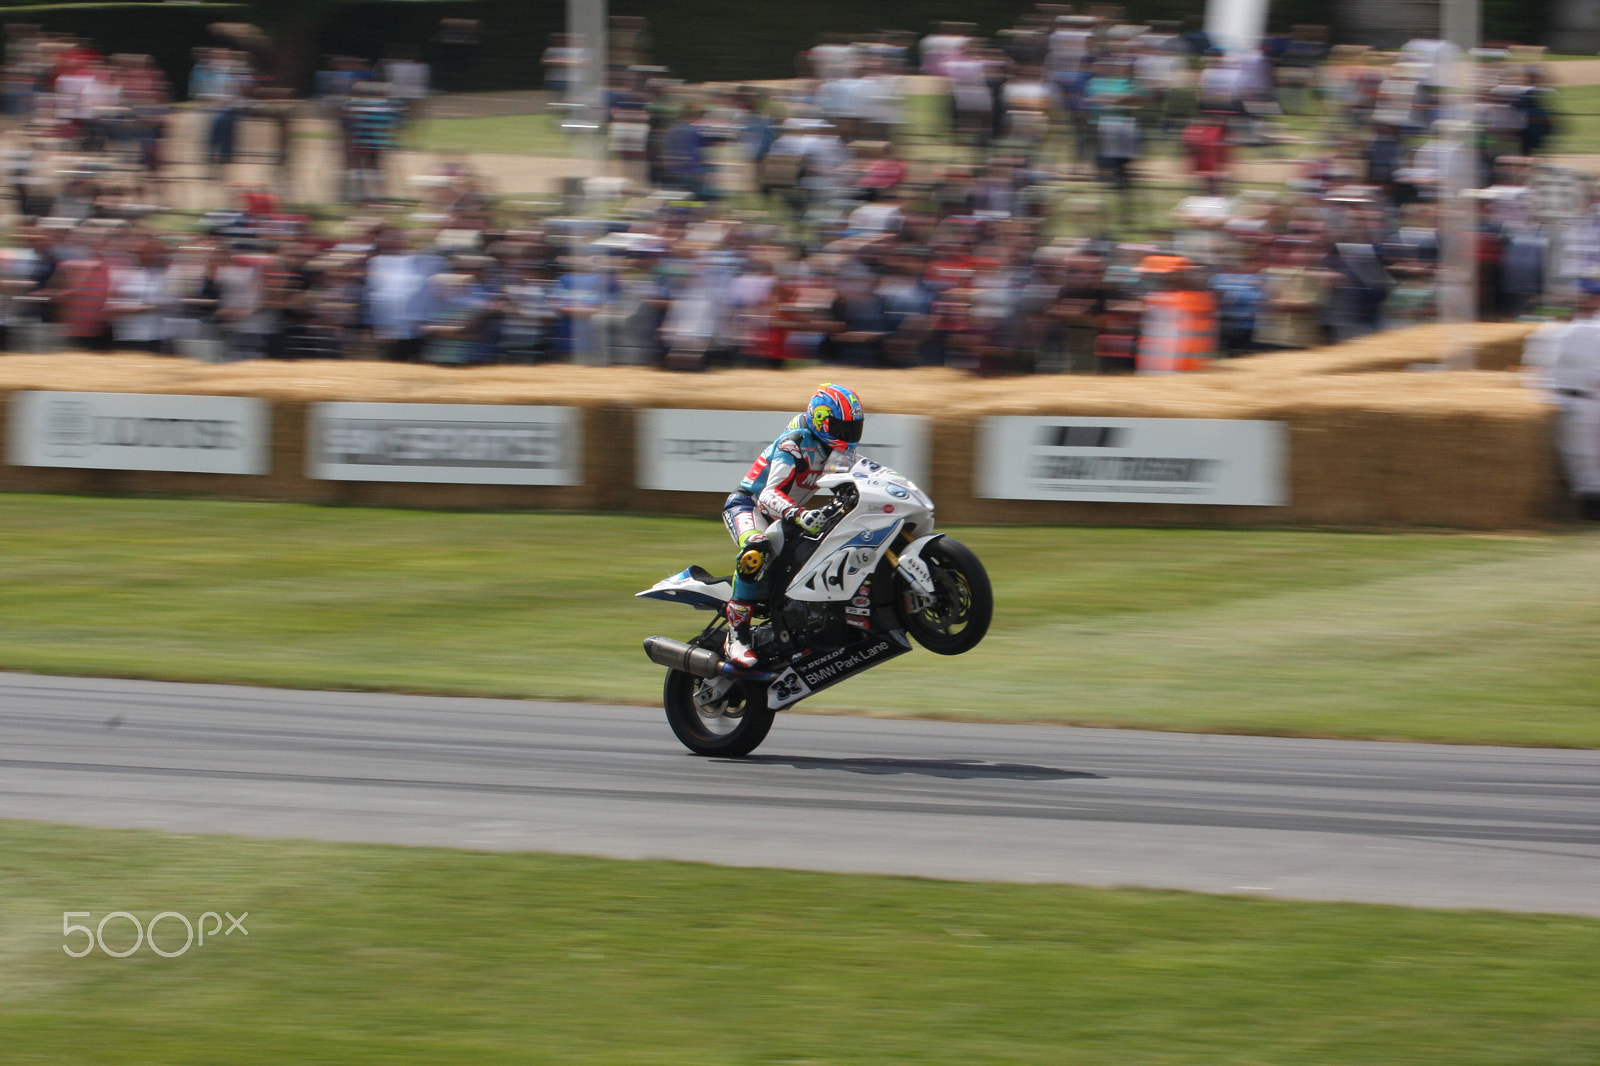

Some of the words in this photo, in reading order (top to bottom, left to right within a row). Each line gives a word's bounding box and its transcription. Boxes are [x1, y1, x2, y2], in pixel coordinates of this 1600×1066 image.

[805, 665, 838, 685] BMW
[834, 655, 862, 672] Park
[858, 641, 890, 660] Lane
[807, 647, 846, 669] DUNLOP
